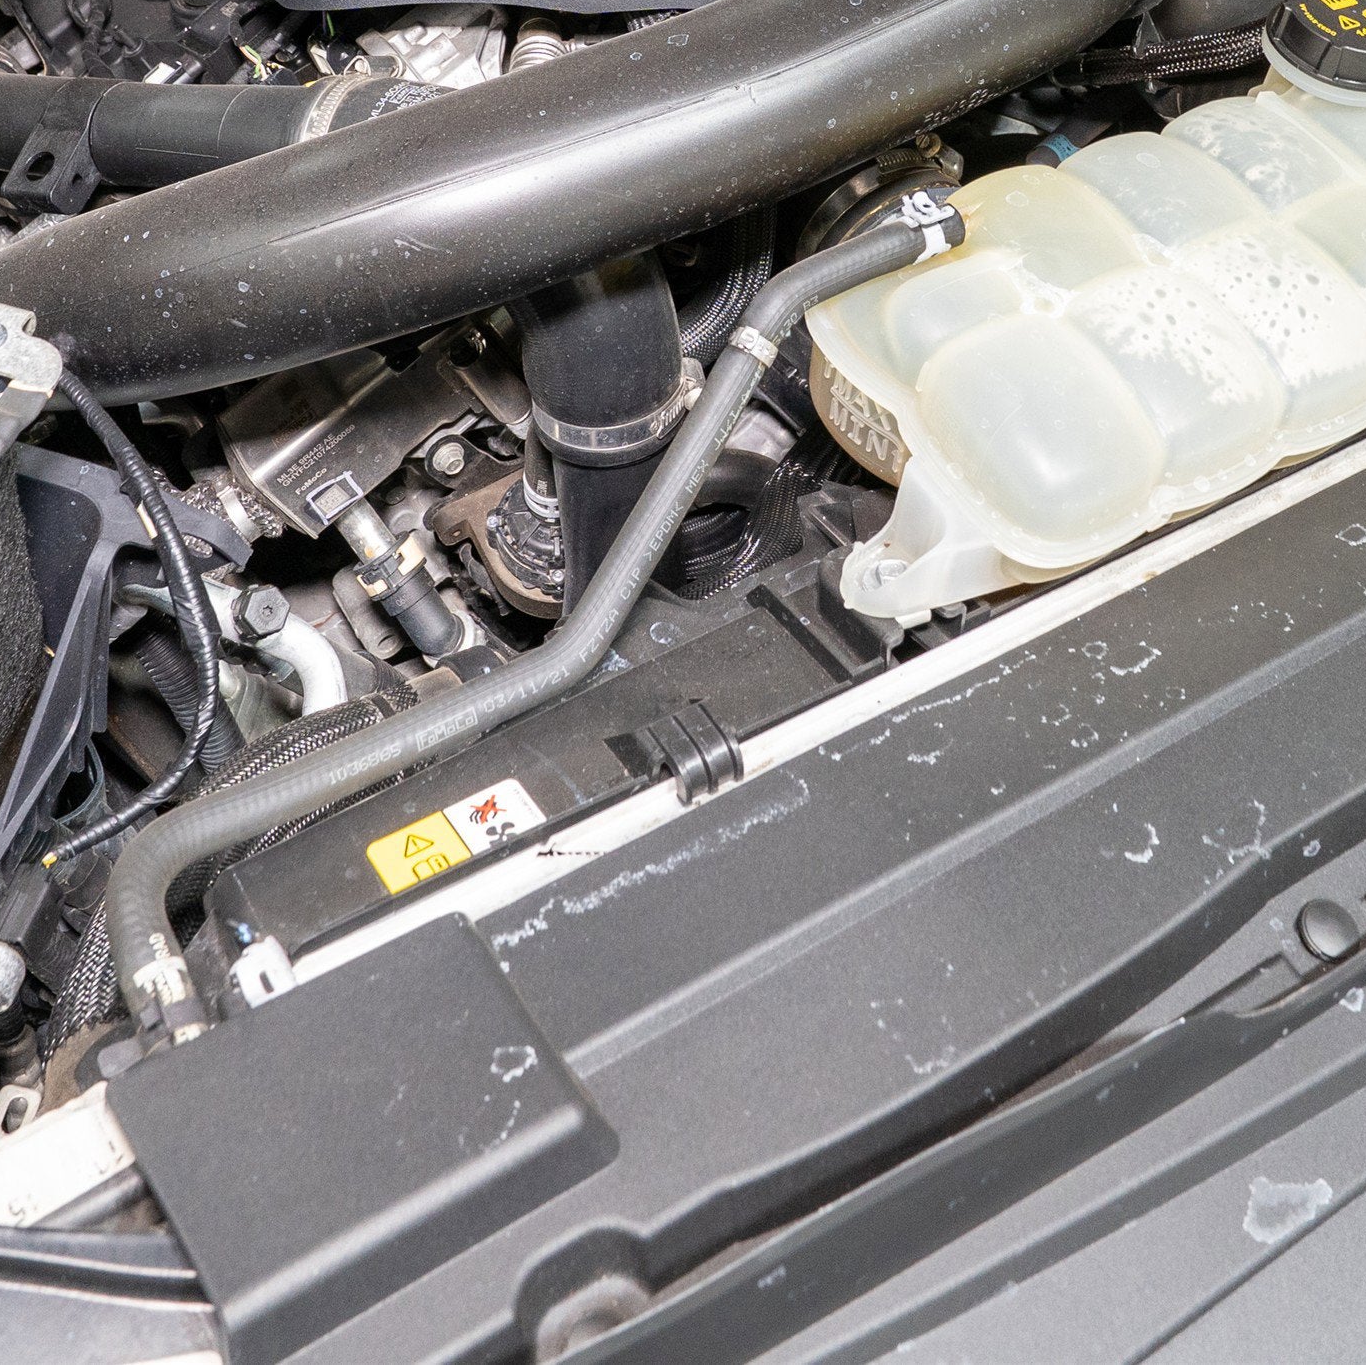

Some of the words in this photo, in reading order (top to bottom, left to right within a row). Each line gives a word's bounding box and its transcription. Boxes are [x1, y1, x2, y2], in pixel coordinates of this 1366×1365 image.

[829, 395, 888, 461] MIN
[276, 463, 300, 484] ML3E
[295, 467, 327, 495] FoMoCo
[418, 712, 475, 749] FoMoCo
[483, 666, 571, 714] 03/11/21
[642, 501, 685, 562] >EPDM<
[684, 459, 709, 495] MEX
